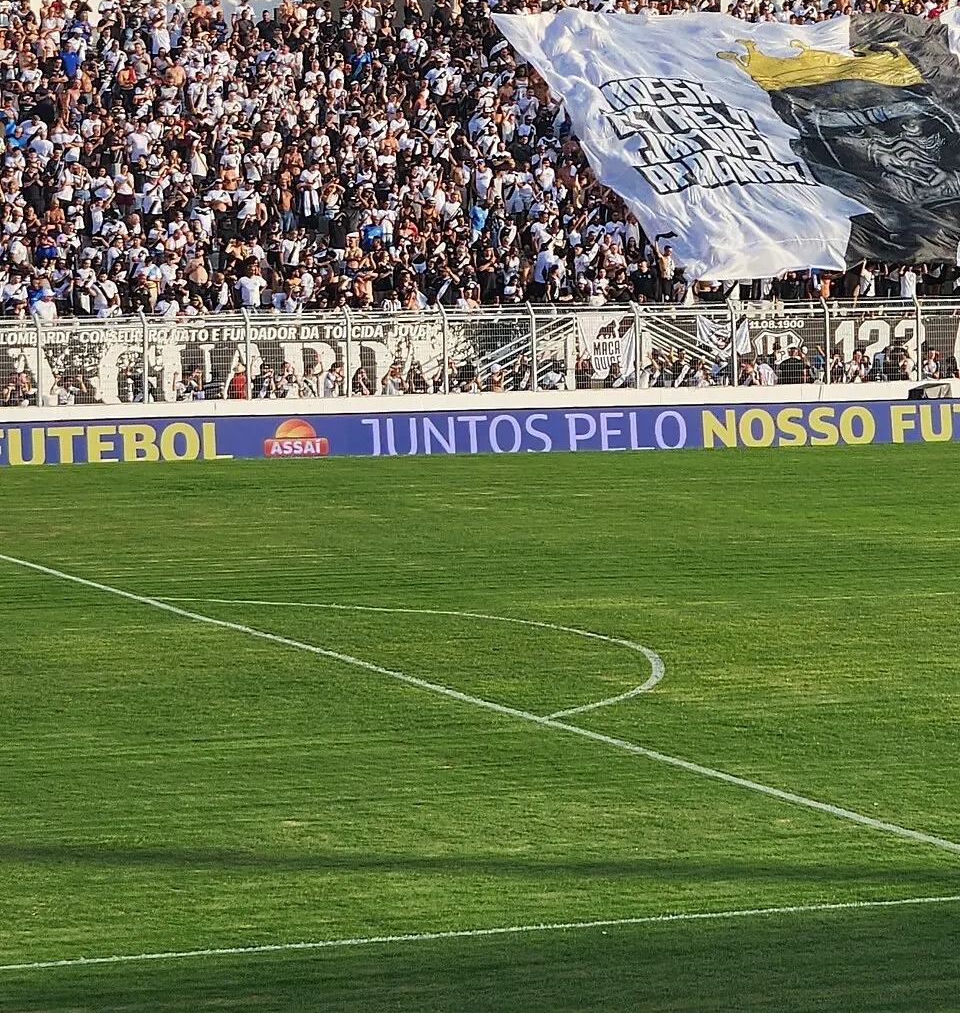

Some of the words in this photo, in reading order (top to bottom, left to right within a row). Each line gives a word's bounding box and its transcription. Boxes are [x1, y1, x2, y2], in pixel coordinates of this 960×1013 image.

[749, 319, 805, 329] 11.08.1900
[80, 329, 168, 344] CONSELHERO
[212, 328, 220, 341] E
[300, 326, 320, 339] DA
[323, 325, 385, 339] TOCIDA
[592, 340, 621, 355] MACA
[0, 422, 234, 466] UTEBOL
[270, 438, 321, 455] ASSAÍ
[361, 413, 552, 456] JUNTOS
[565, 410, 687, 451] PELO
[702, 406, 876, 448] NOSSO
